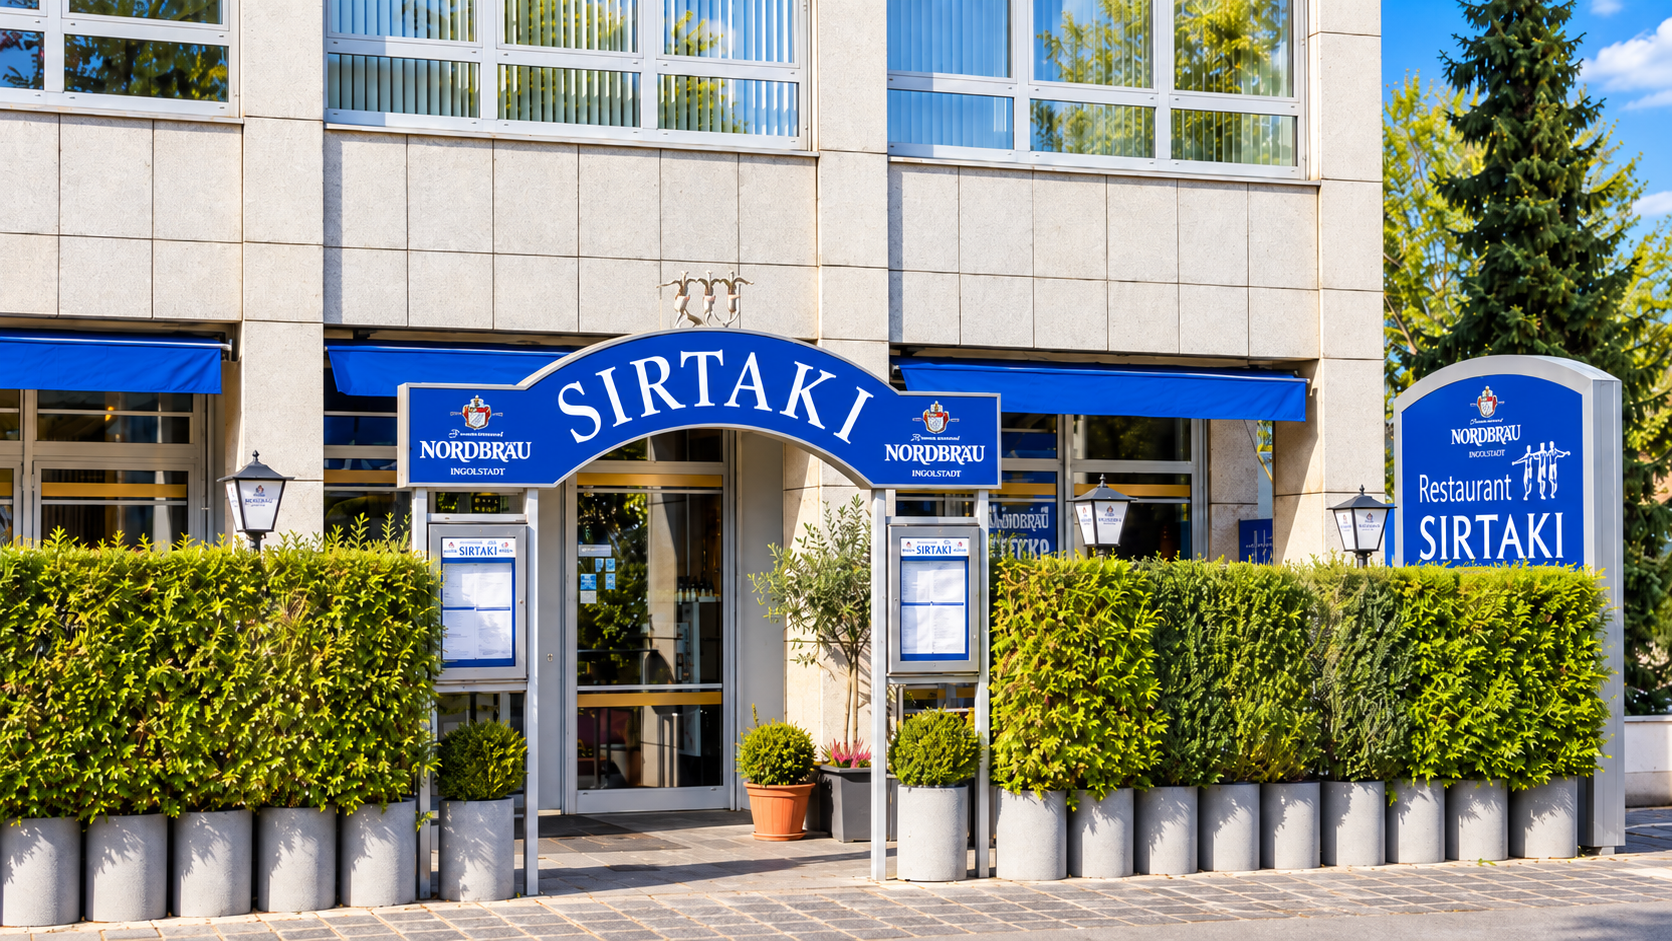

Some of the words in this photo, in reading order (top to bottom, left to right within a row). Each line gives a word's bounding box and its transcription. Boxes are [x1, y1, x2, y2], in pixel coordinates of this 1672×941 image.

[557, 349, 874, 444] SIRTAKI
[1450, 424, 1522, 447] NORDBRÄU
[419, 440, 533, 463] NORDBRÄU
[884, 444, 986, 466] NORDBRÄU
[450, 467, 506, 476] INGOLSTADT
[911, 469, 962, 478] INGOLSTADT
[1419, 473, 1512, 503] Restaurant
[1419, 512, 1564, 561] SIRTAKI
[458, 545, 498, 556] SIRTAKI
[916, 545, 952, 555] SIRTAKI
